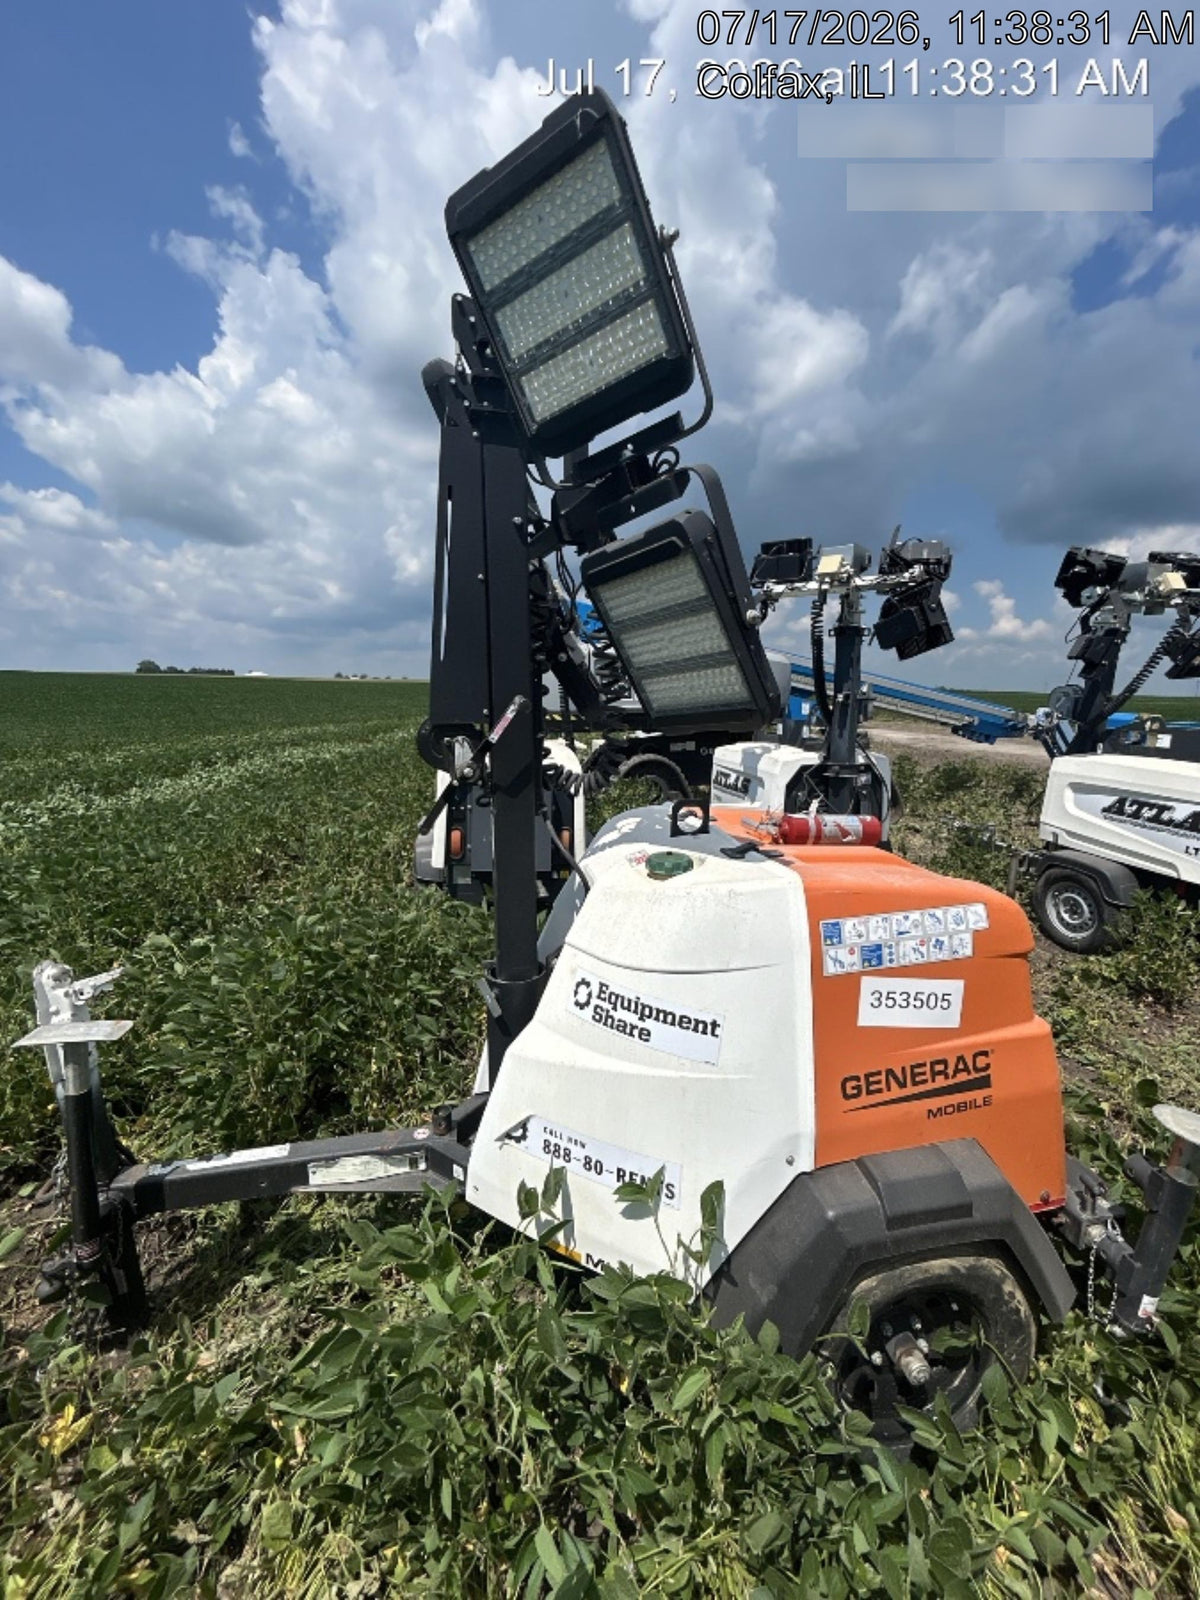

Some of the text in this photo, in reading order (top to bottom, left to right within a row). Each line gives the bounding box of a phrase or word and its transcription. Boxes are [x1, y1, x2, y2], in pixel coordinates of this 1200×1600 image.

[713, 769, 752, 796] ATLAS
[596, 981, 721, 1038] Equipment
[870, 990, 953, 1011] 353505
[591, 1004, 652, 1043] Share
[840, 1050, 992, 1101] GENERAC
[927, 1095, 993, 1121] MOBILE
[542, 1138, 676, 1200] 888-80-RENS
